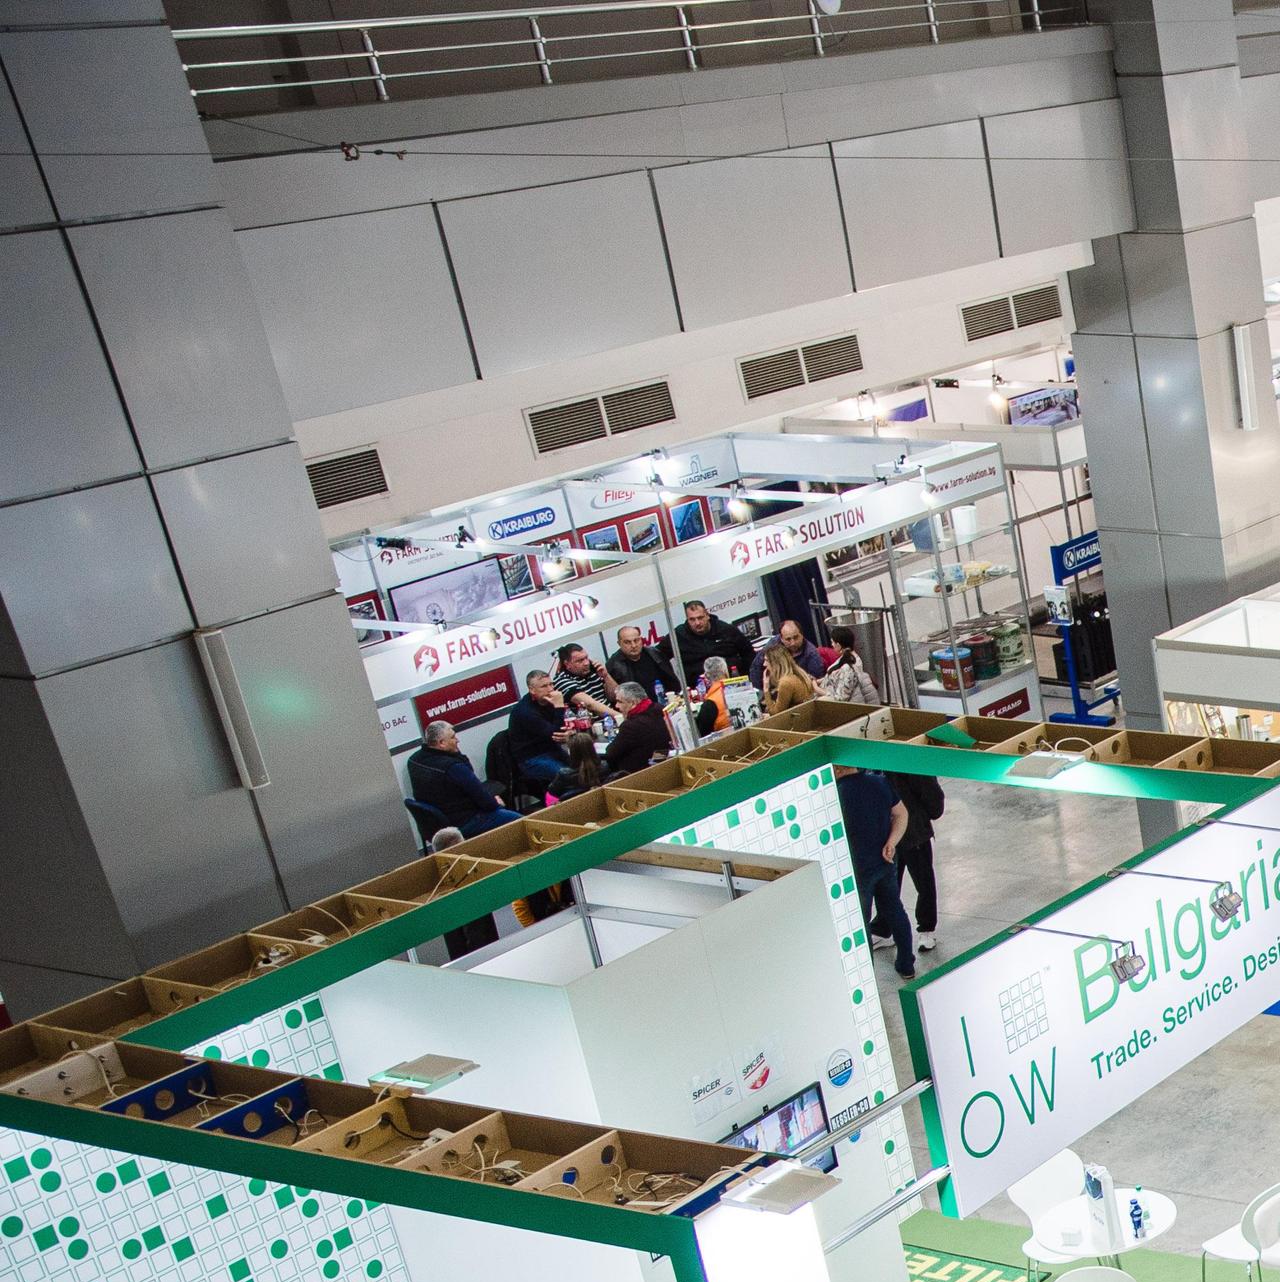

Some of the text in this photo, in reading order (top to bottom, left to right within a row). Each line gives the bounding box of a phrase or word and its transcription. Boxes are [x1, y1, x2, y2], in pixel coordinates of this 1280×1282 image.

[679, 468, 719, 488] WAGNER
[503, 510, 554, 535] KRAIBURG
[799, 505, 865, 544] SOLUTION
[503, 600, 585, 646] SOLUTION
[426, 682, 507, 718] www.farm-solution.bg
[1090, 1033, 1158, 1079] Trade.
[1163, 977, 1238, 1034] Service.
[693, 1079, 721, 1100] SPICER
